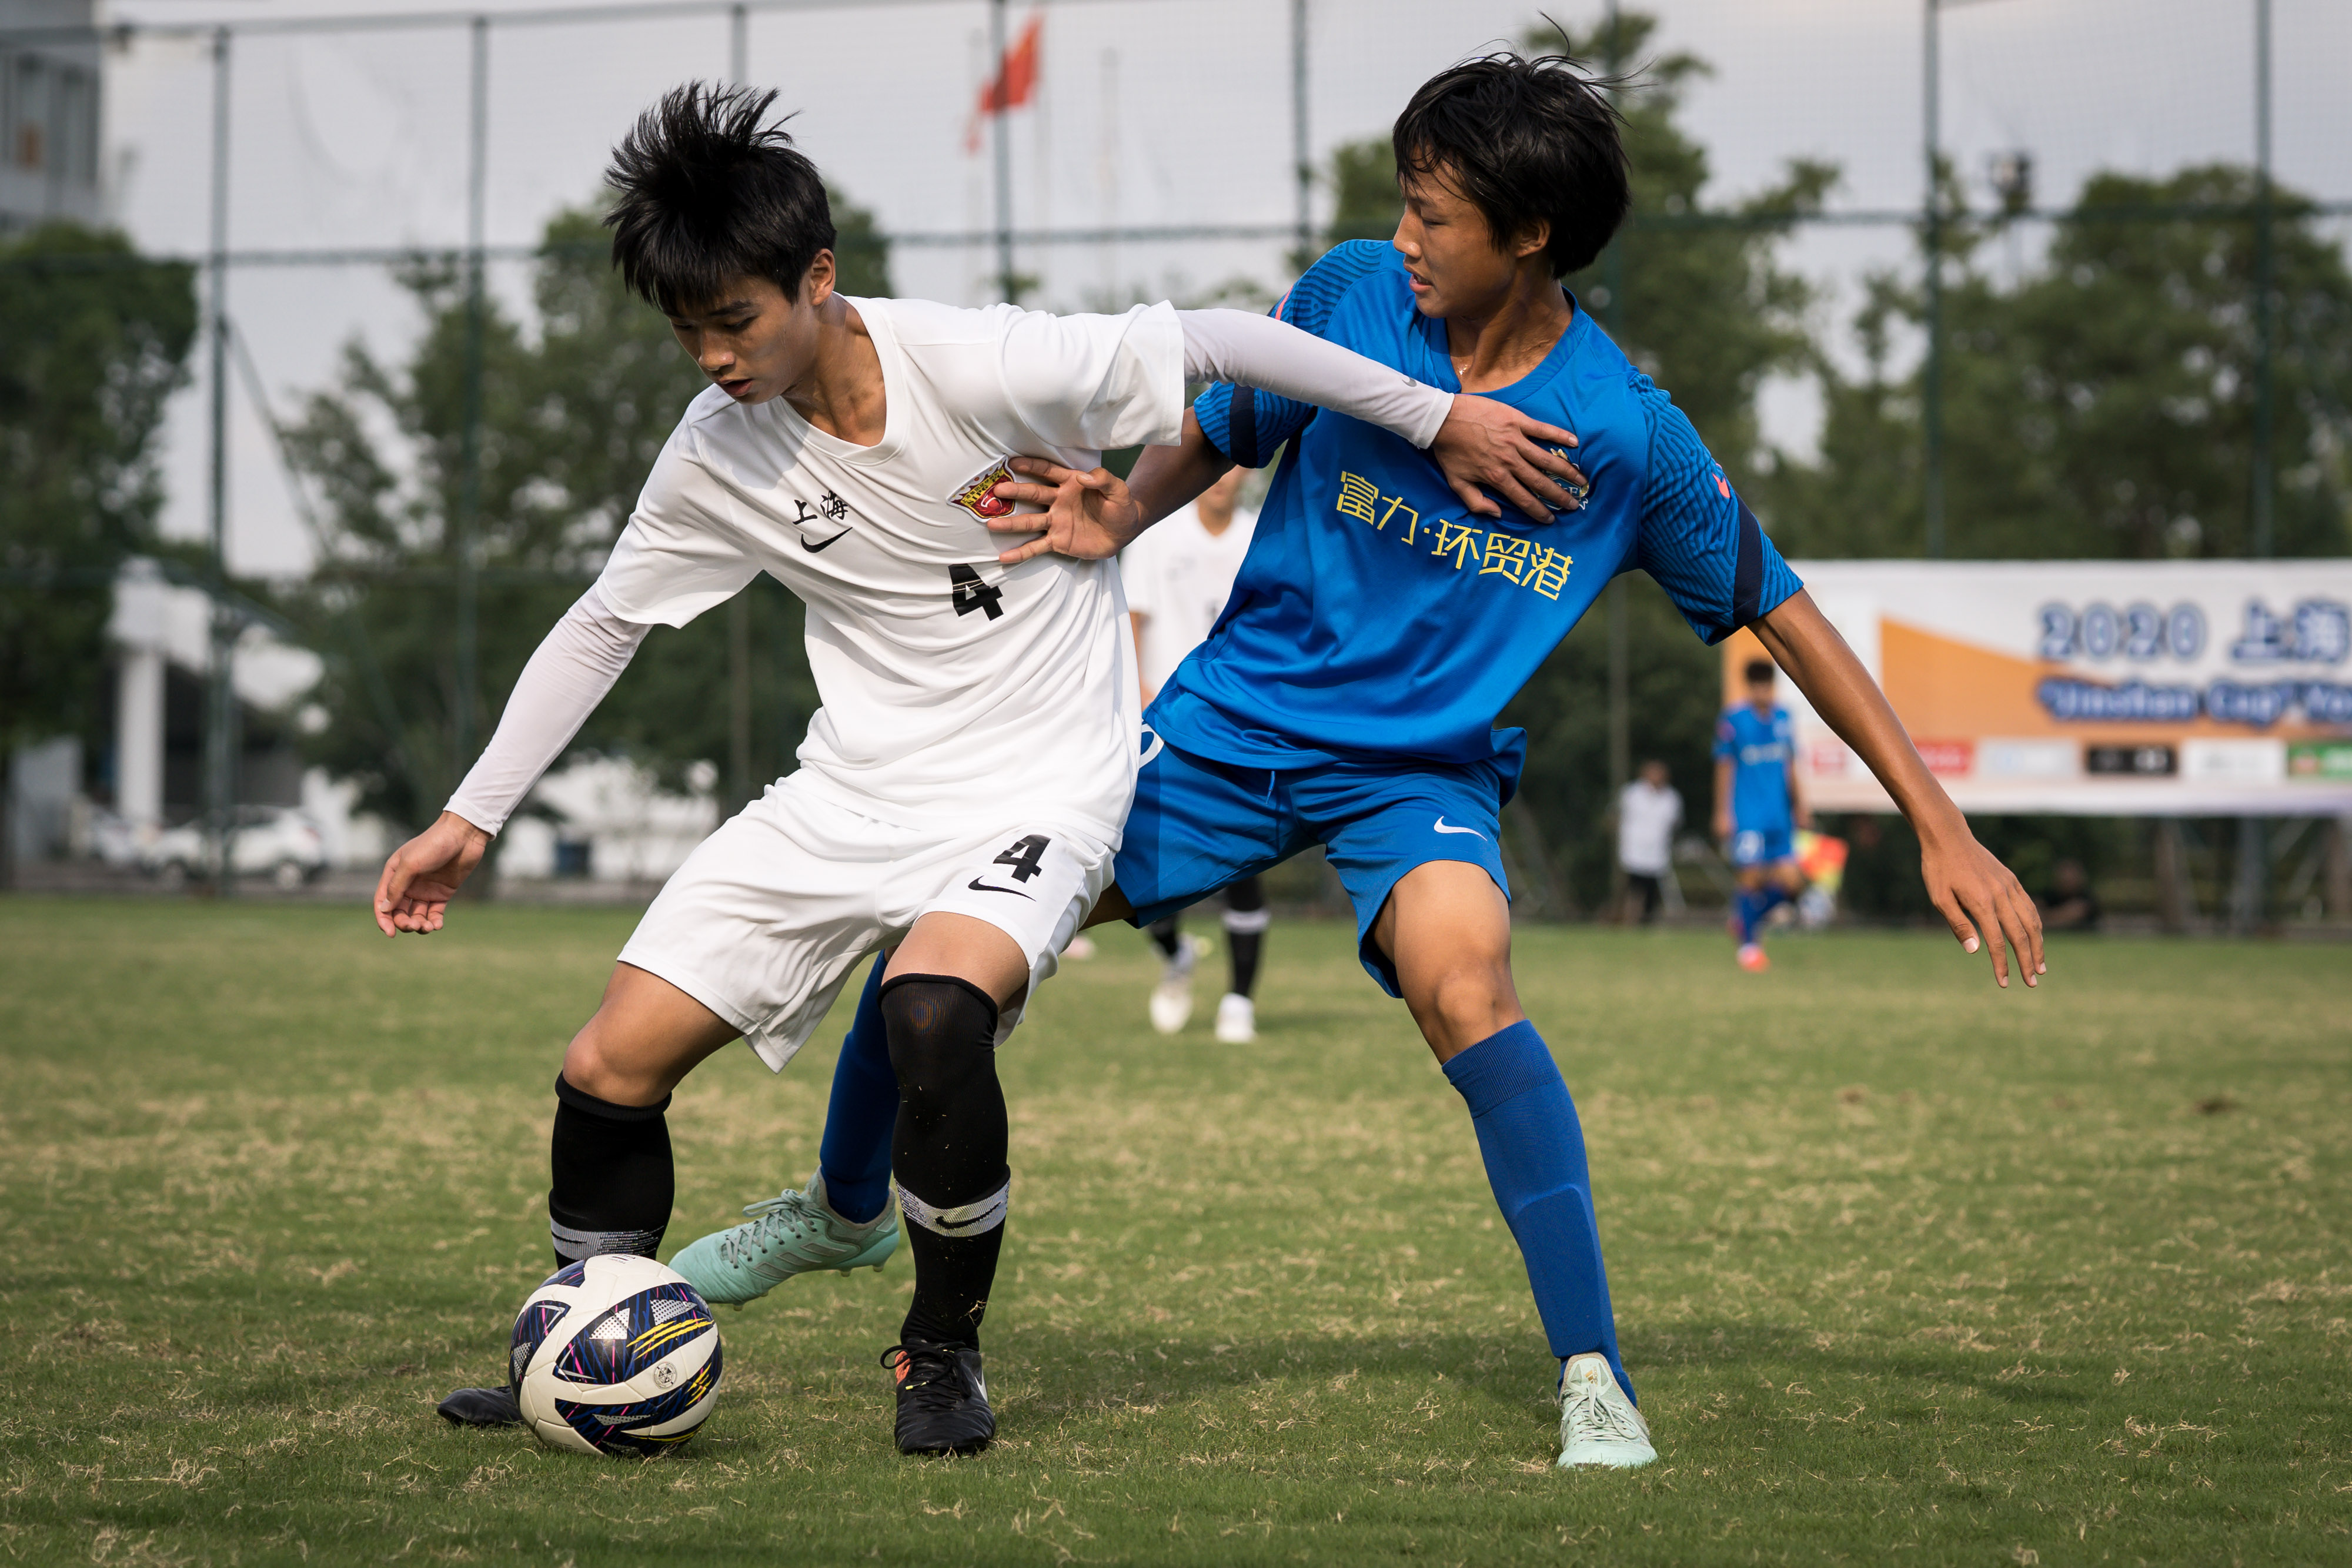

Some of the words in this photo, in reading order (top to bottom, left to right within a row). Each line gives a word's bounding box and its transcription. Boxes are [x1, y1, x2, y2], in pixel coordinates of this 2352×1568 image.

[793, 490, 849, 526] 上海
[948, 563, 1004, 621] 4
[2038, 601, 2209, 664] 2020
[993, 834, 1051, 884] 4
